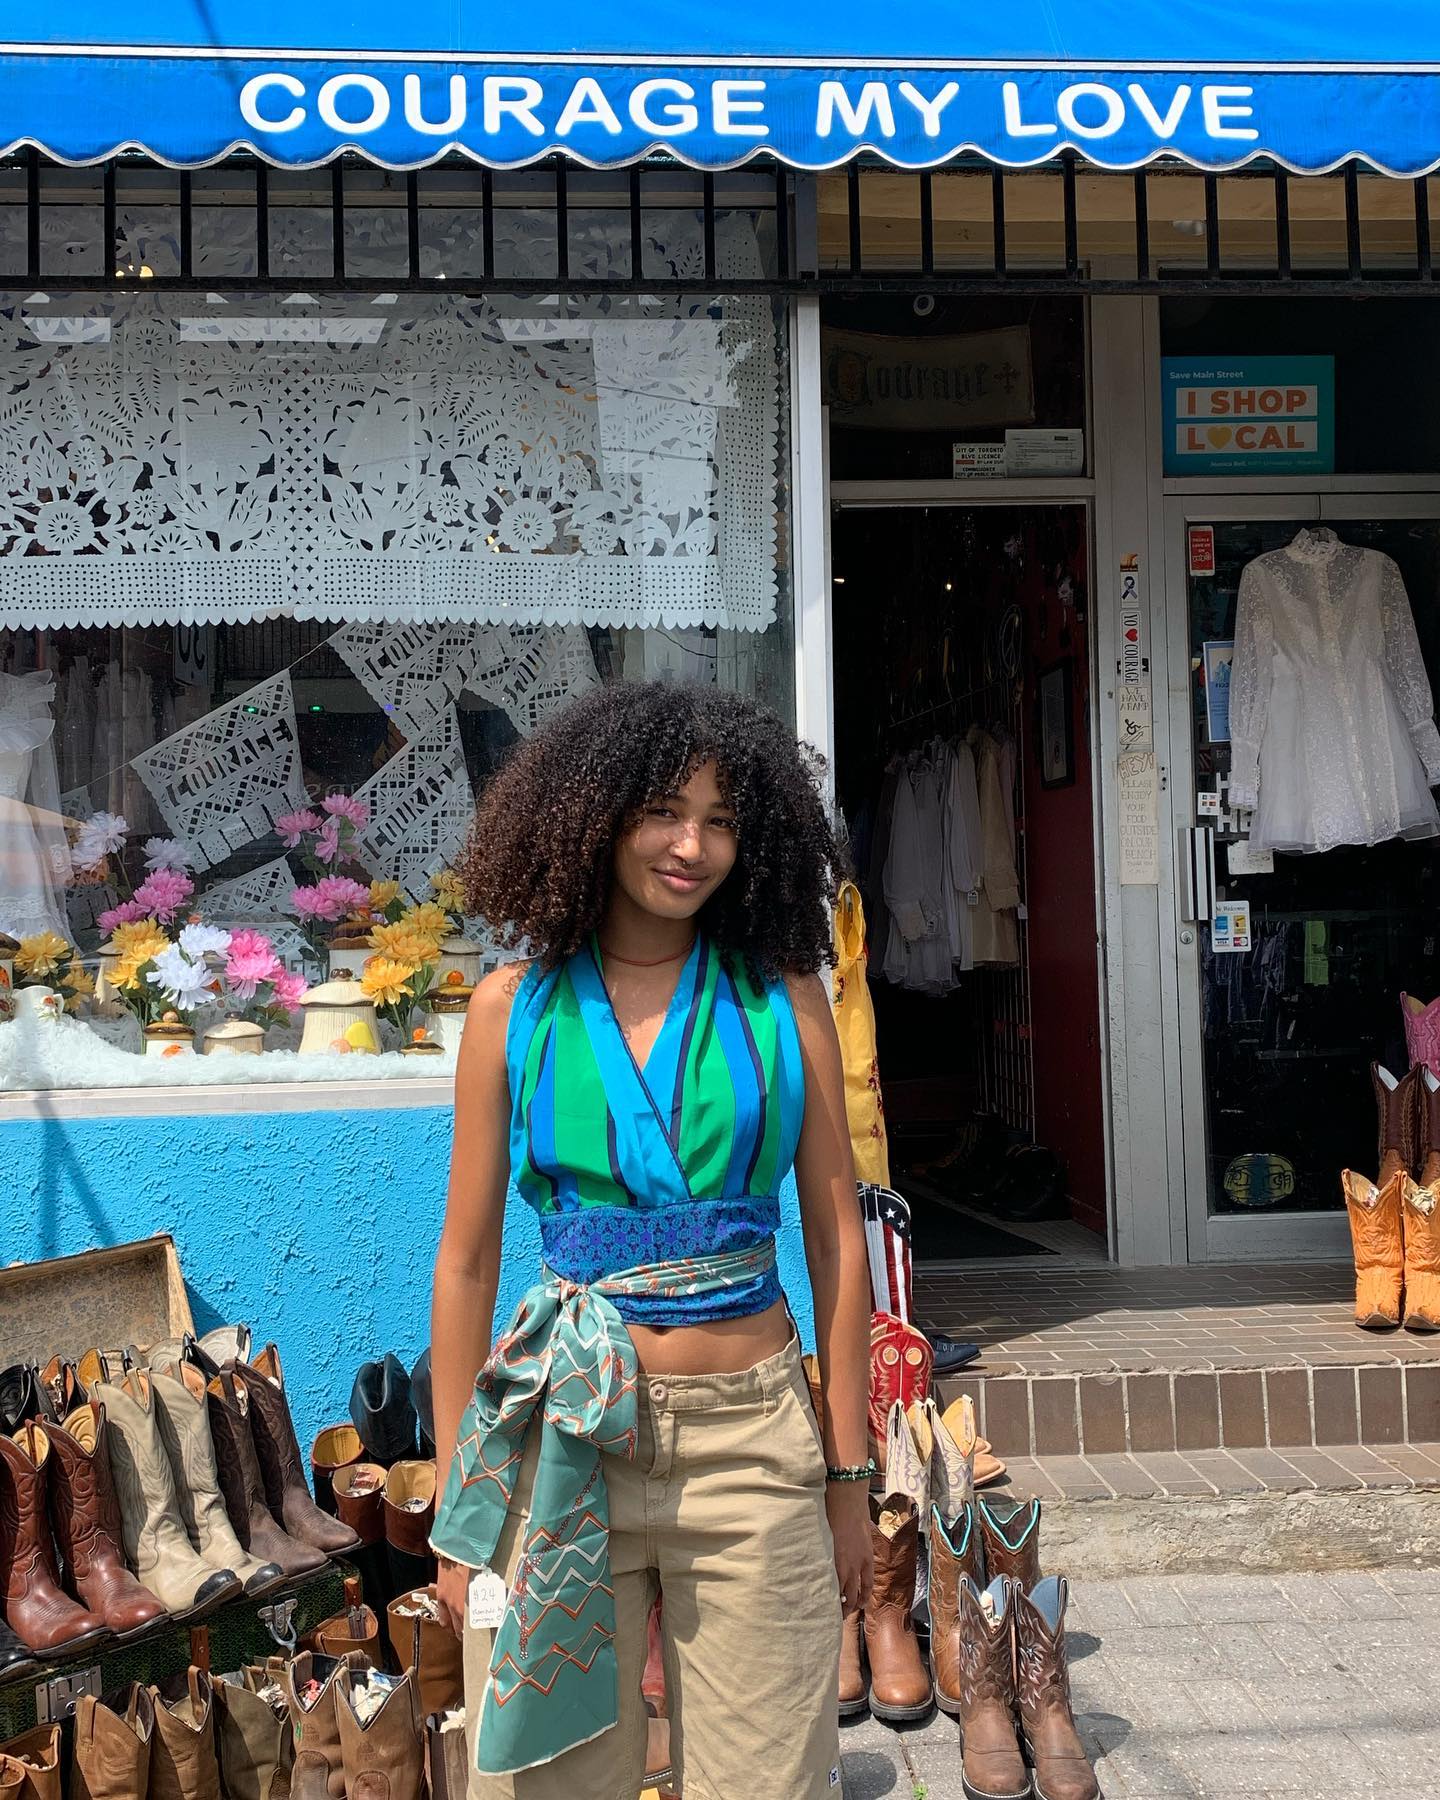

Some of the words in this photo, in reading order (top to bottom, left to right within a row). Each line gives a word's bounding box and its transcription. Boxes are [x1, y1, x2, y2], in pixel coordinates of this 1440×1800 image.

[239, 72, 770, 136] COURAGE
[816, 81, 959, 138] MY
[1002, 82, 1259, 140] LOVE
[1169, 371, 1191, 379] Save
[1193, 371, 1215, 379] Main
[1217, 371, 1244, 379] Street
[1187, 391, 1196, 415] I
[1210, 389, 1307, 415] SHOP
[1123, 614, 1138, 627] YO
[1124, 644, 1139, 684] COURAGE
[1126, 687, 1142, 695] WE
[1121, 694, 1146, 702] HAVE
[1127, 702, 1149, 711] RAMP
[166, 718, 294, 807] COURAGE
[1119, 752, 1154, 780] HEY!
[1122, 779, 1152, 788] PLEASE
[1121, 791, 1152, 800] ENJOY
[1126, 803, 1146, 812] YOUR
[1127, 815, 1147, 823] FOOD
[1120, 825, 1159, 835] OUTSIDE
[1125, 849, 1157, 859] BENCH
[473, 1586, 497, 1601] $24
